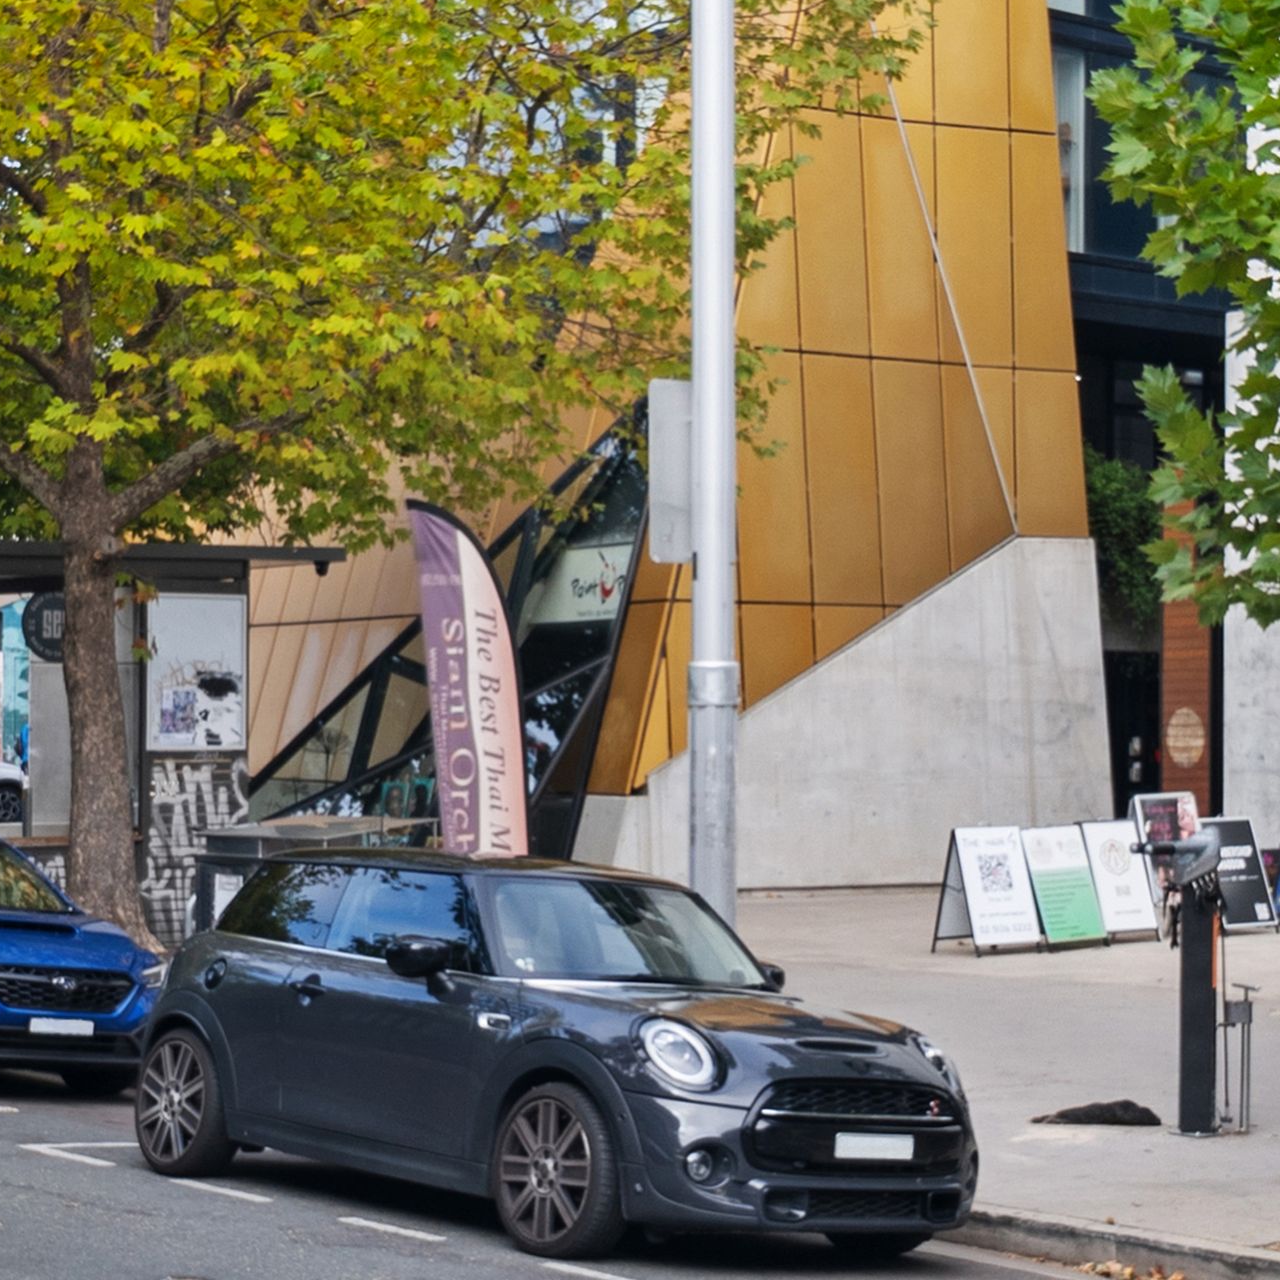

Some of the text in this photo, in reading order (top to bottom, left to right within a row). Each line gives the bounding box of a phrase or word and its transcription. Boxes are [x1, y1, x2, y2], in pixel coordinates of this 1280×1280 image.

[474, 608, 498, 663] The
[442, 617, 467, 730] Siam
[479, 673, 500, 735] Best
[483, 746, 509, 813] Thai
